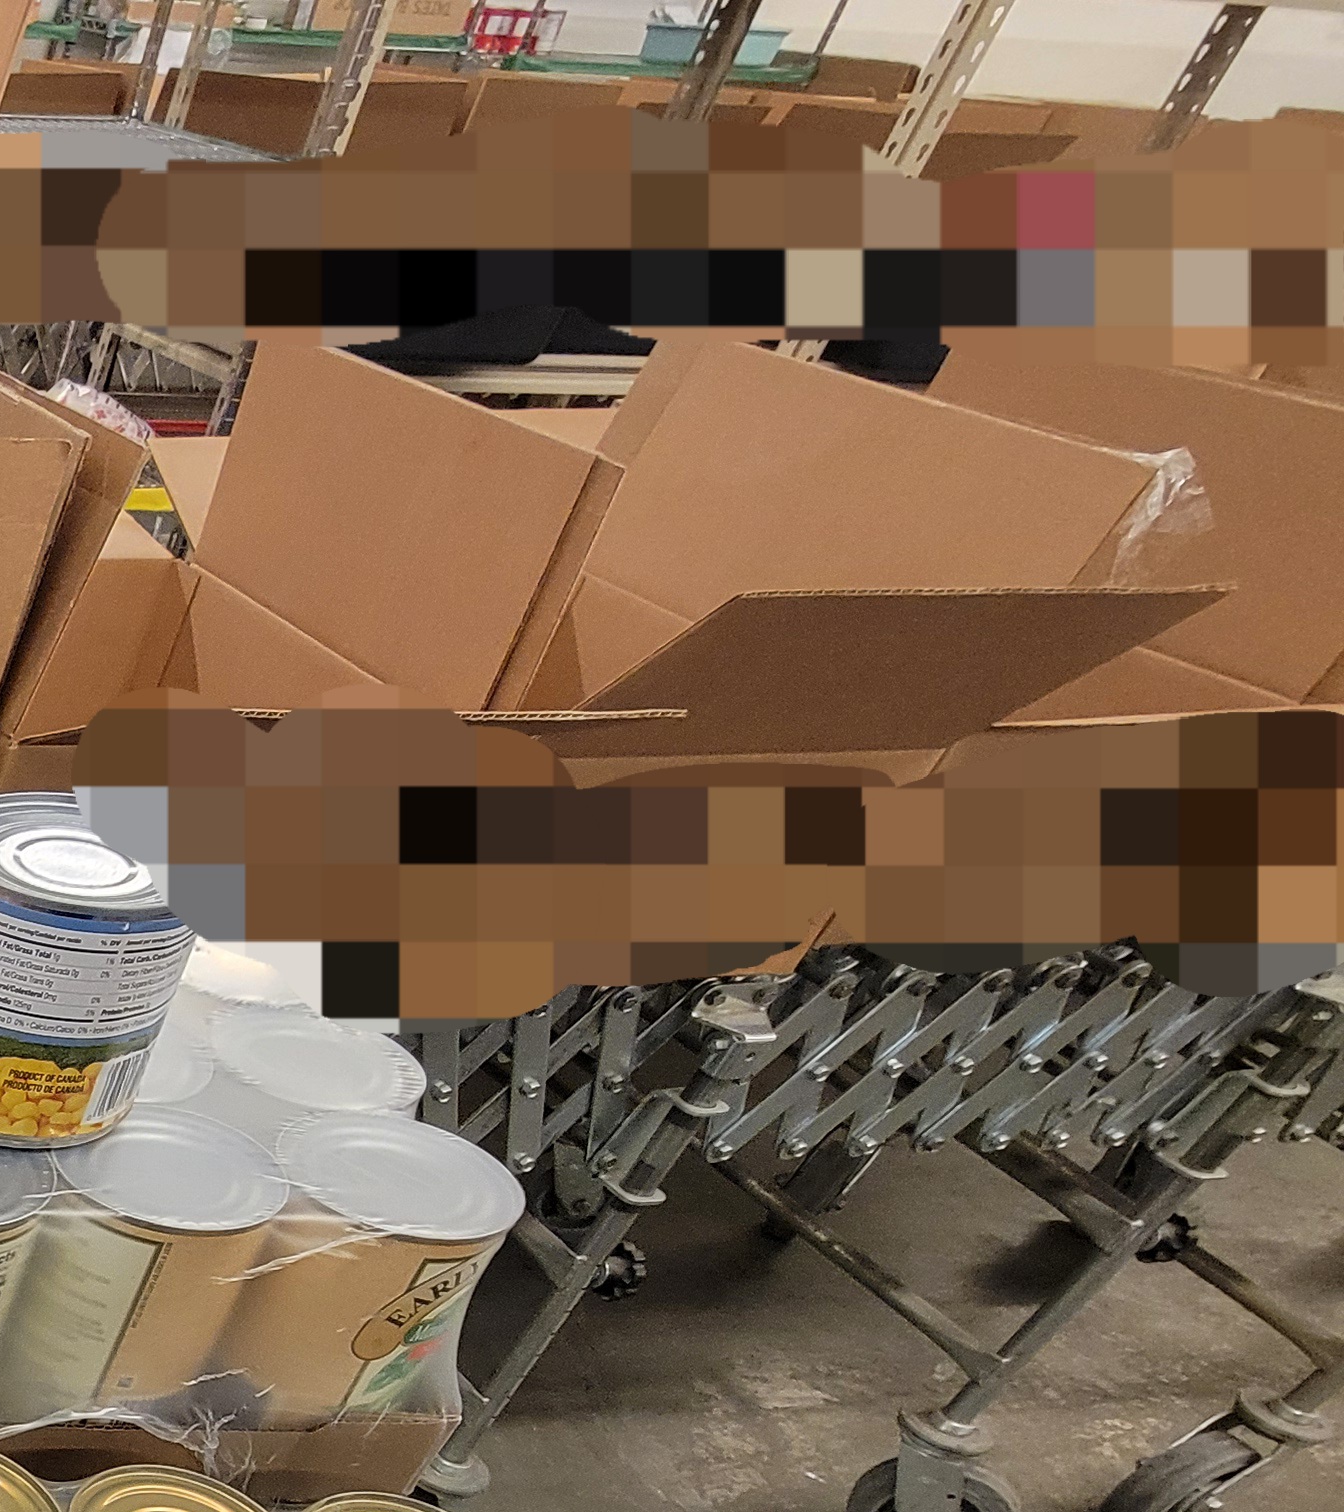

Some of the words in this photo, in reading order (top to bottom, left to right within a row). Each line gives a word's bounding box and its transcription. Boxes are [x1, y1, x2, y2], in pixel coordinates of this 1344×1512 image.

[35, 948, 52, 959] Total
[8, 1068, 44, 1083] PRODUCT
[45, 1073, 56, 1083] OF
[56, 1073, 88, 1084] CANADA
[2, 1078, 44, 1093] PRODUCTO
[44, 1083, 55, 1093] DE
